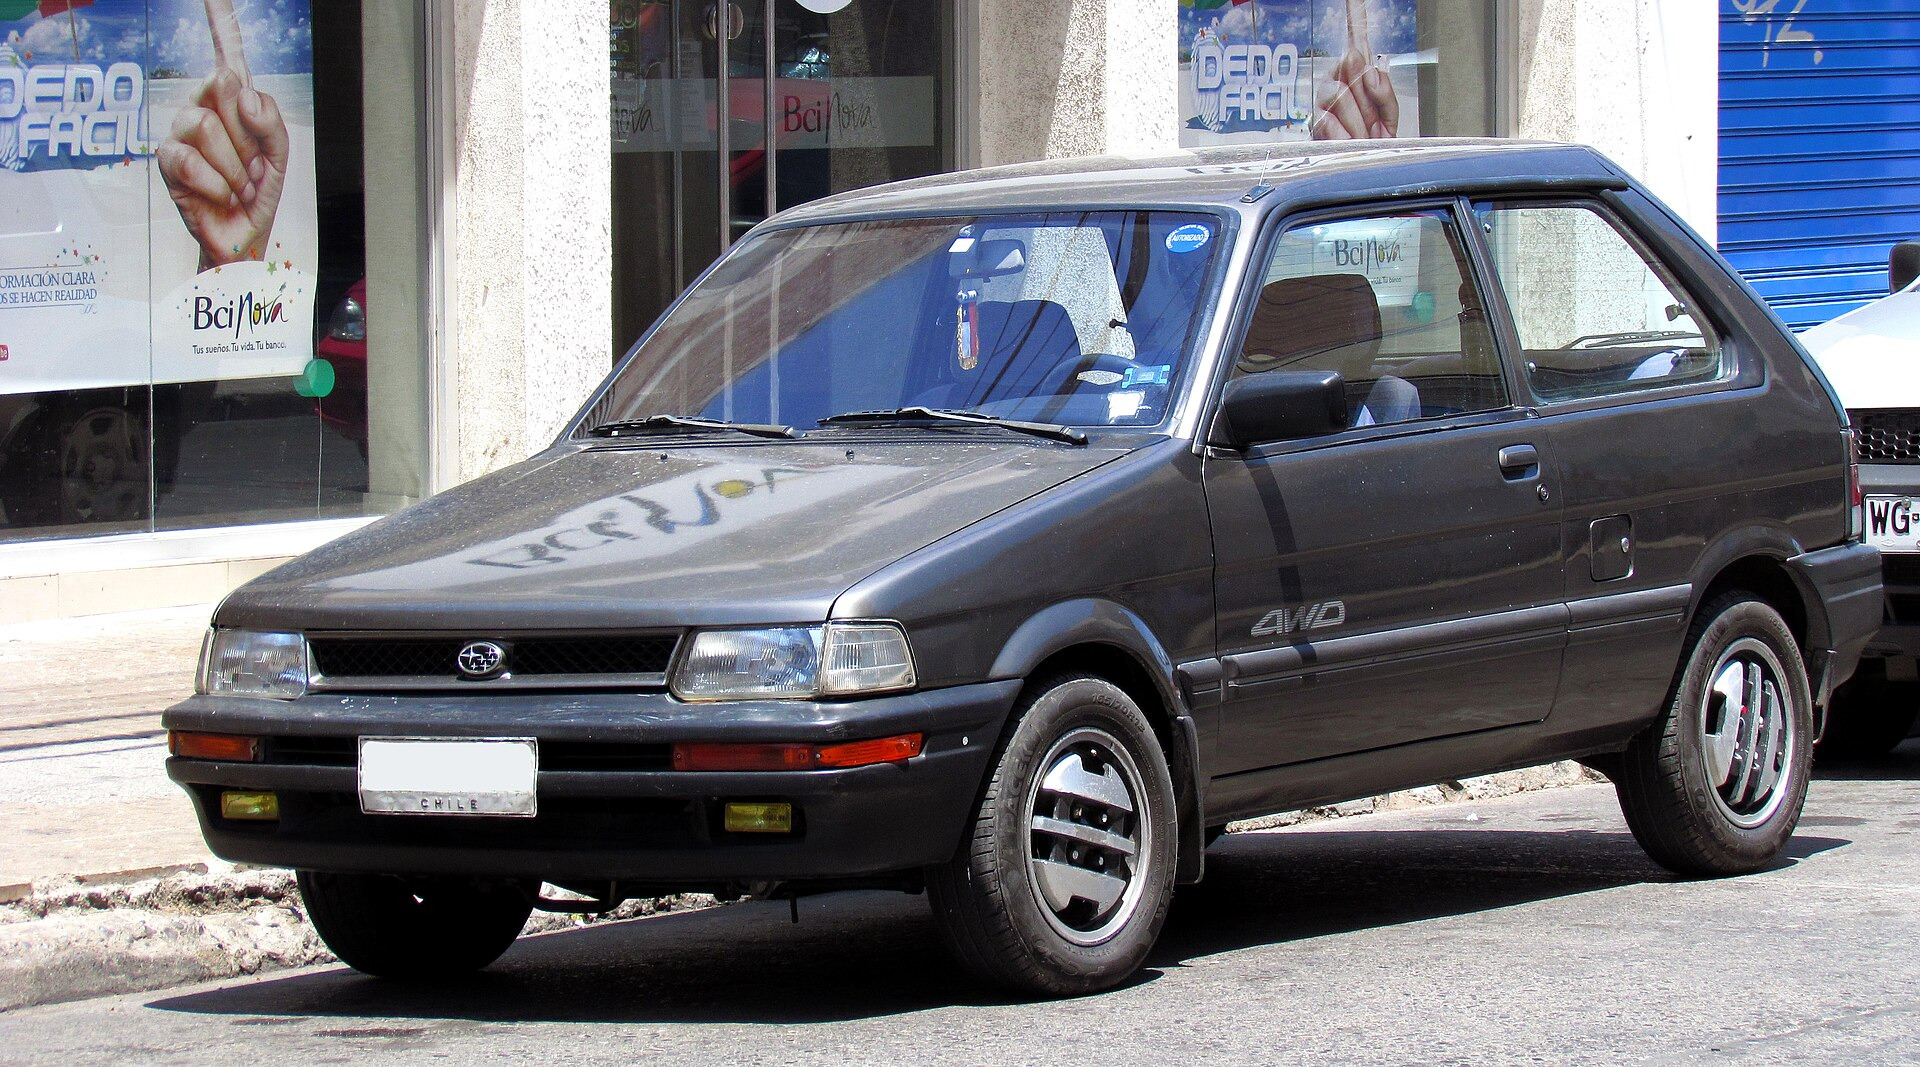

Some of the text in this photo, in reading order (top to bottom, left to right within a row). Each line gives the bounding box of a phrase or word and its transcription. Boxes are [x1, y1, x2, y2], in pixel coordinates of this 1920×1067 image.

[1197, 43, 1298, 89] DEDO
[0, 62, 144, 118] DEDO
[62, 271, 96, 286] CLARA
[9, 292, 19, 304] SE
[21, 290, 53, 303] HACEN
[55, 288, 97, 301] REALIDAD
[192, 340, 287, 355] Tus sueños. Tu vida. Tu banco.
[1250, 600, 1345, 638] 4WD
[420, 798, 478, 810] CHILE
